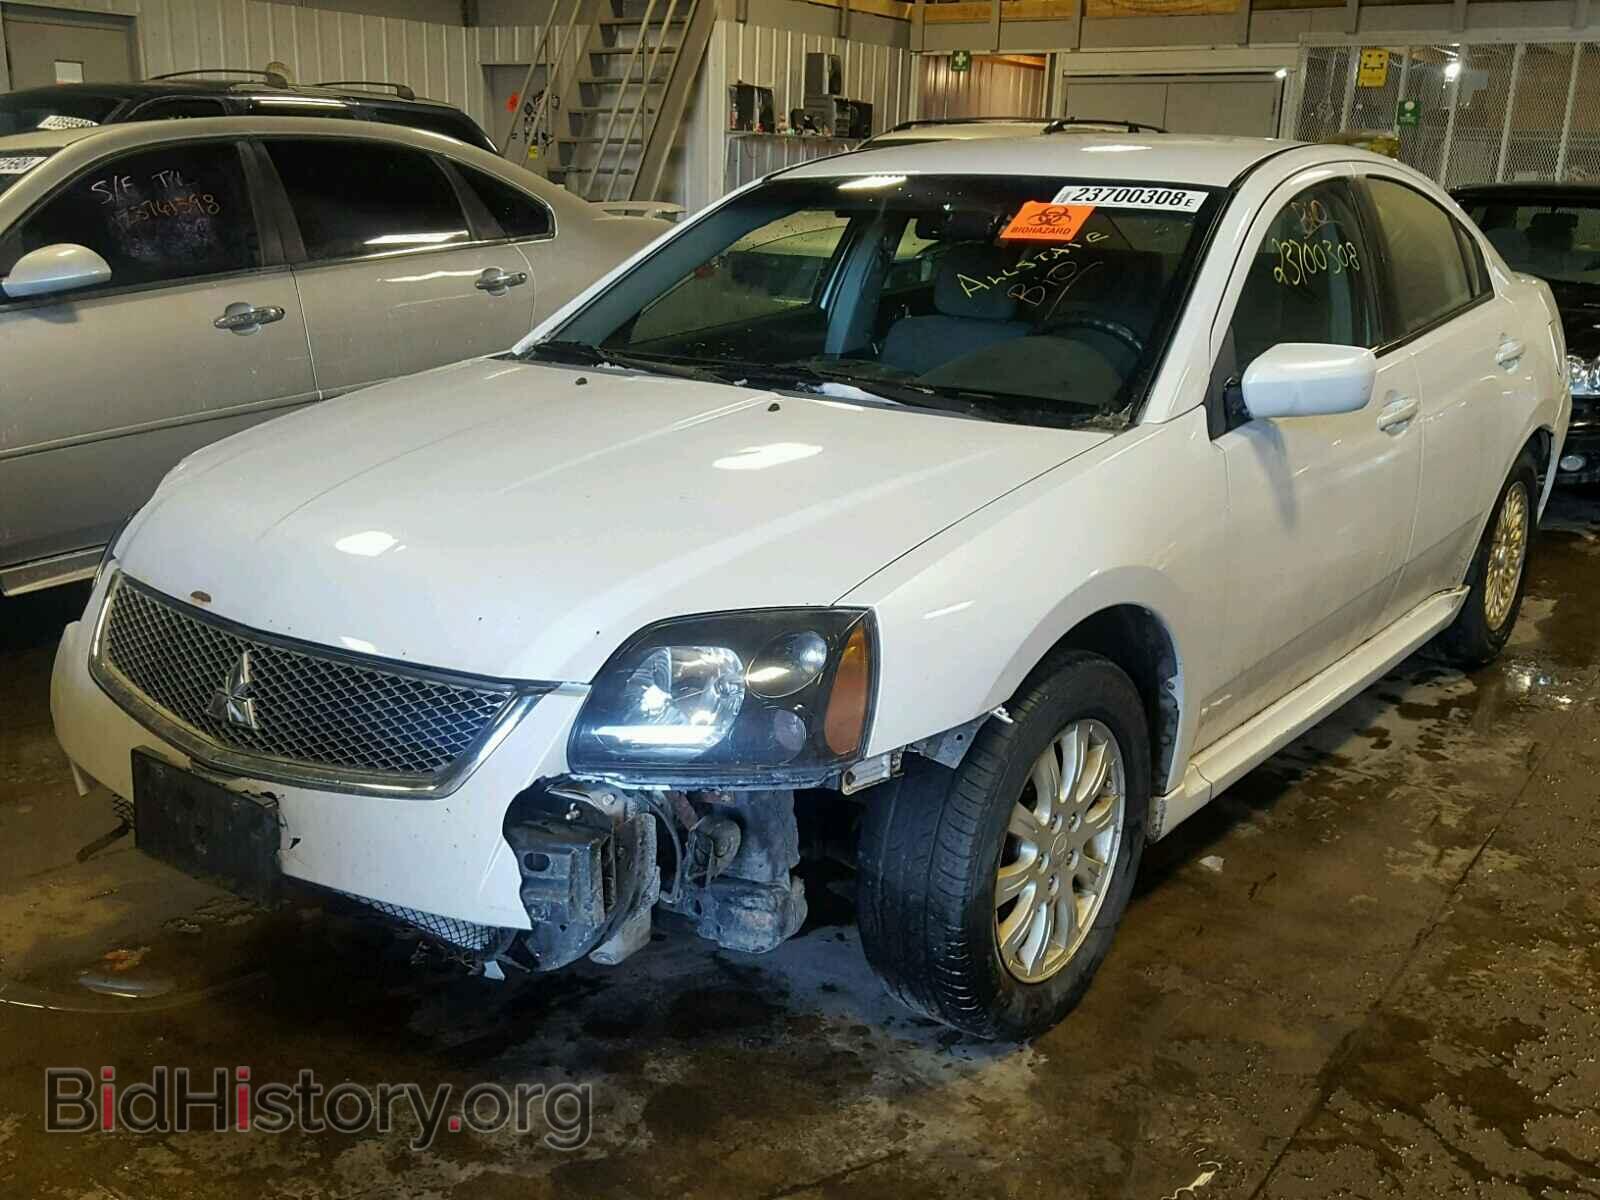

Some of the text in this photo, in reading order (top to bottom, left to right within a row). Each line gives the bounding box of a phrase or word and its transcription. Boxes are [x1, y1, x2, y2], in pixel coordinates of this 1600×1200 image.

[1072, 188, 1186, 206] 23700308
[1010, 226, 1072, 235] BIOHAZARD
[1272, 238, 1360, 285] 23700308
